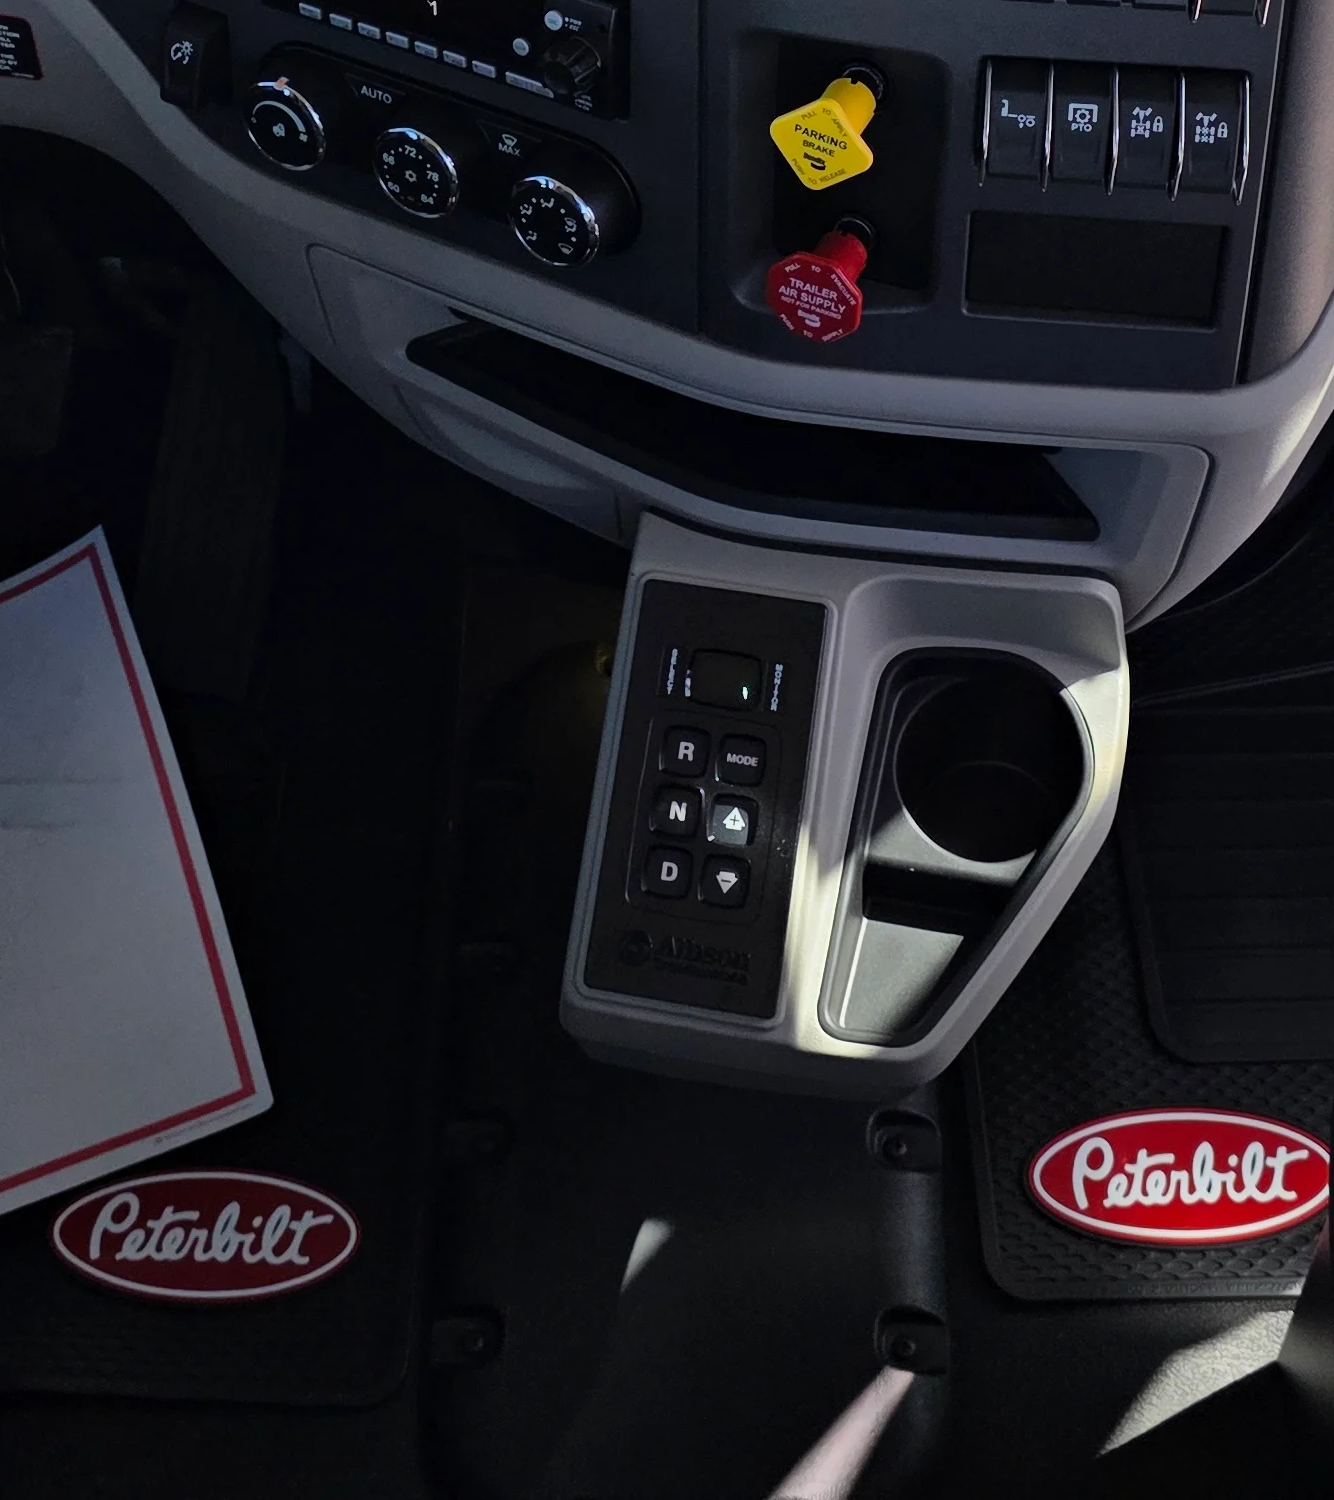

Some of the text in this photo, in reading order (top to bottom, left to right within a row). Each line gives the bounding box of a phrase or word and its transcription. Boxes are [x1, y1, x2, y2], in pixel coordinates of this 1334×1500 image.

[360, 85, 393, 104] AUTO
[801, 107, 848, 137] PULL TO APPLY
[1071, 122, 1093, 132] PTO
[794, 123, 848, 150] PARKING
[404, 145, 417, 158] 72
[498, 142, 521, 157] MAX
[802, 139, 836, 157] BRAKE
[426, 171, 439, 182] 78
[818, 168, 847, 183] RELEASE
[387, 181, 400, 193] 60
[420, 194, 434, 205] 84
[784, 262, 857, 306] PULL TO EVACUATE
[789, 277, 838, 301] TRAILER
[778, 285, 846, 314] AIR SUPPLY
[780, 295, 842, 320] NOT FOR PARKING
[802, 329, 814, 338] TO
[677, 741, 695, 762] R
[726, 752, 759, 768] MODE
[668, 802, 687, 822] N
[660, 861, 679, 882] D
[1072, 1137, 1310, 1210] Peterbilt
[89, 1191, 335, 1266] Peterbilt
